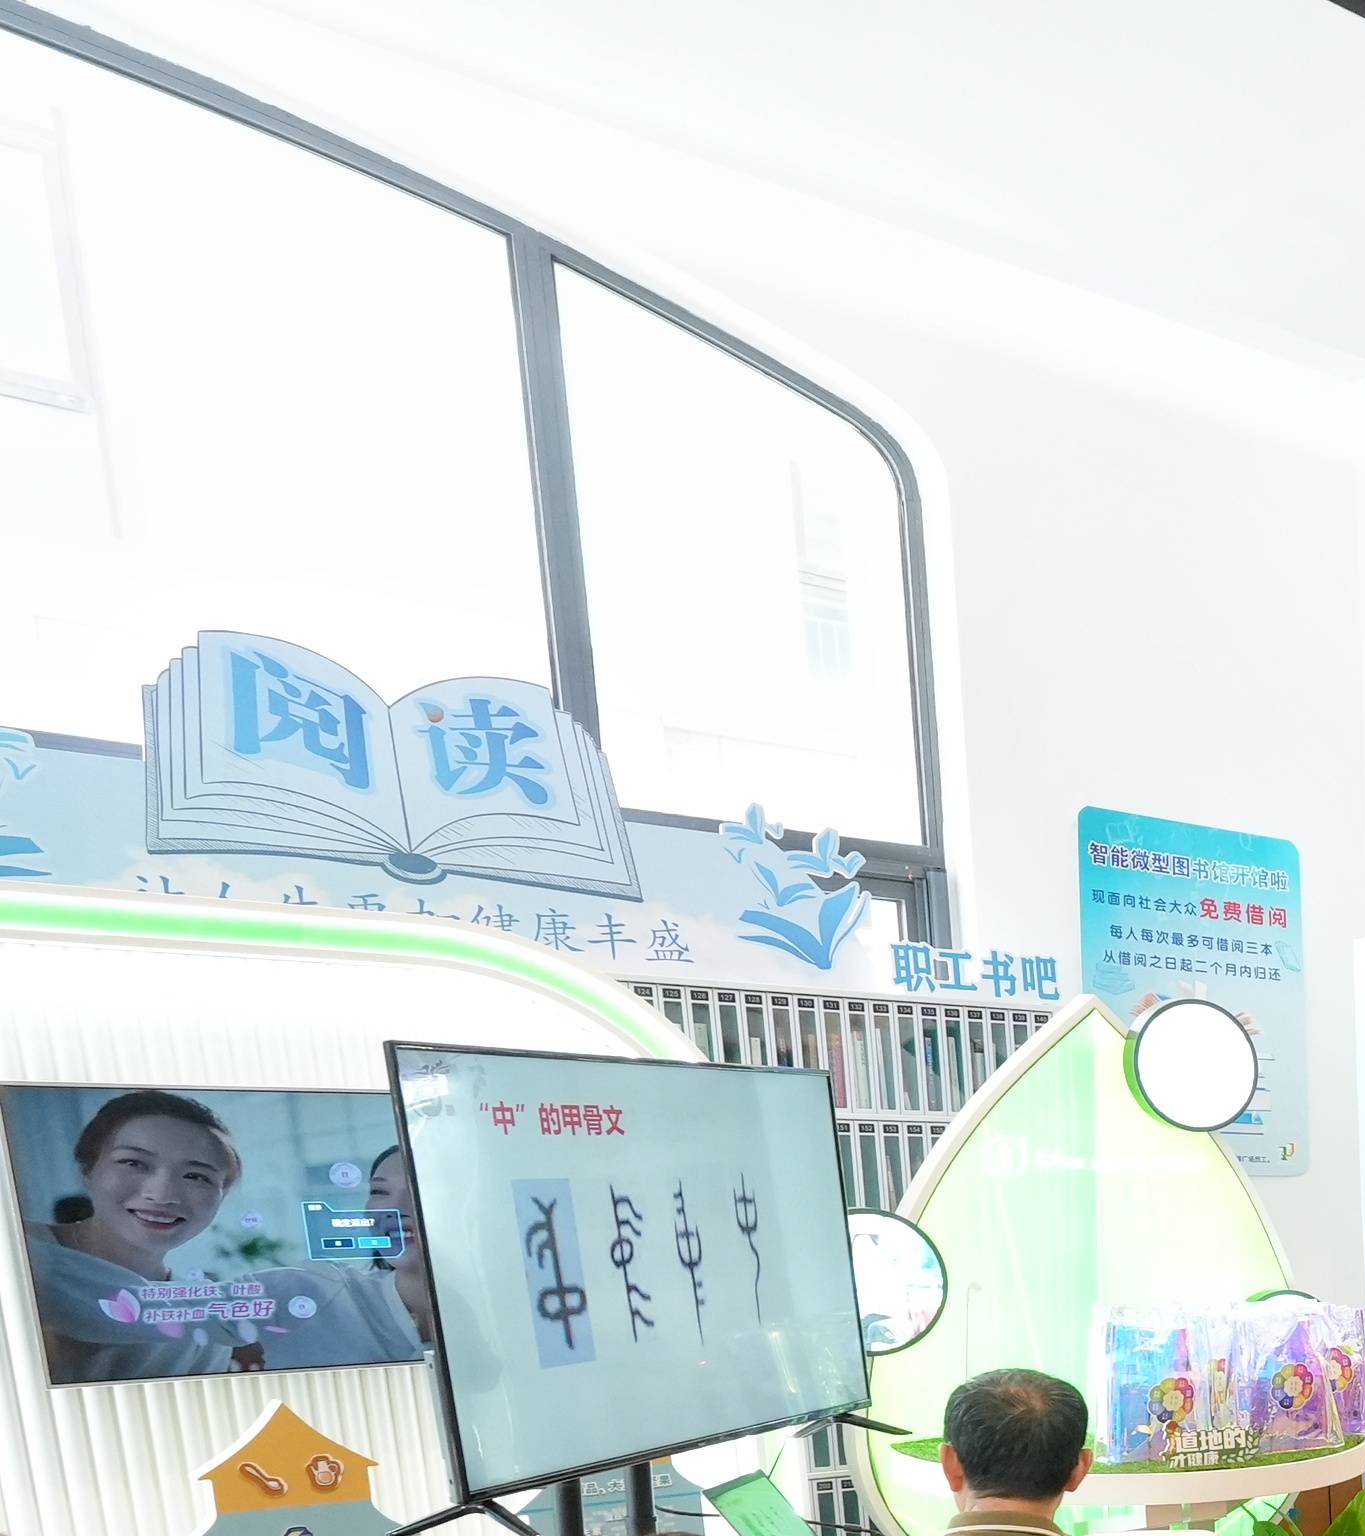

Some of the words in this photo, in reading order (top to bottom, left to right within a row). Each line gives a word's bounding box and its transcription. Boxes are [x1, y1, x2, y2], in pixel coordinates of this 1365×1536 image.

[228, 650, 550, 806] 阅读
[1089, 842, 1289, 891] 智能微型图书馆开馆啦
[1110, 924, 1273, 957] 每人每次最多可借阅三本
[891, 943, 1060, 1001] 职工书吧
[1103, 950, 1281, 981] 从借阅之日起二个月内归还
[144, 1299, 275, 1323] 补铁补血气色好
